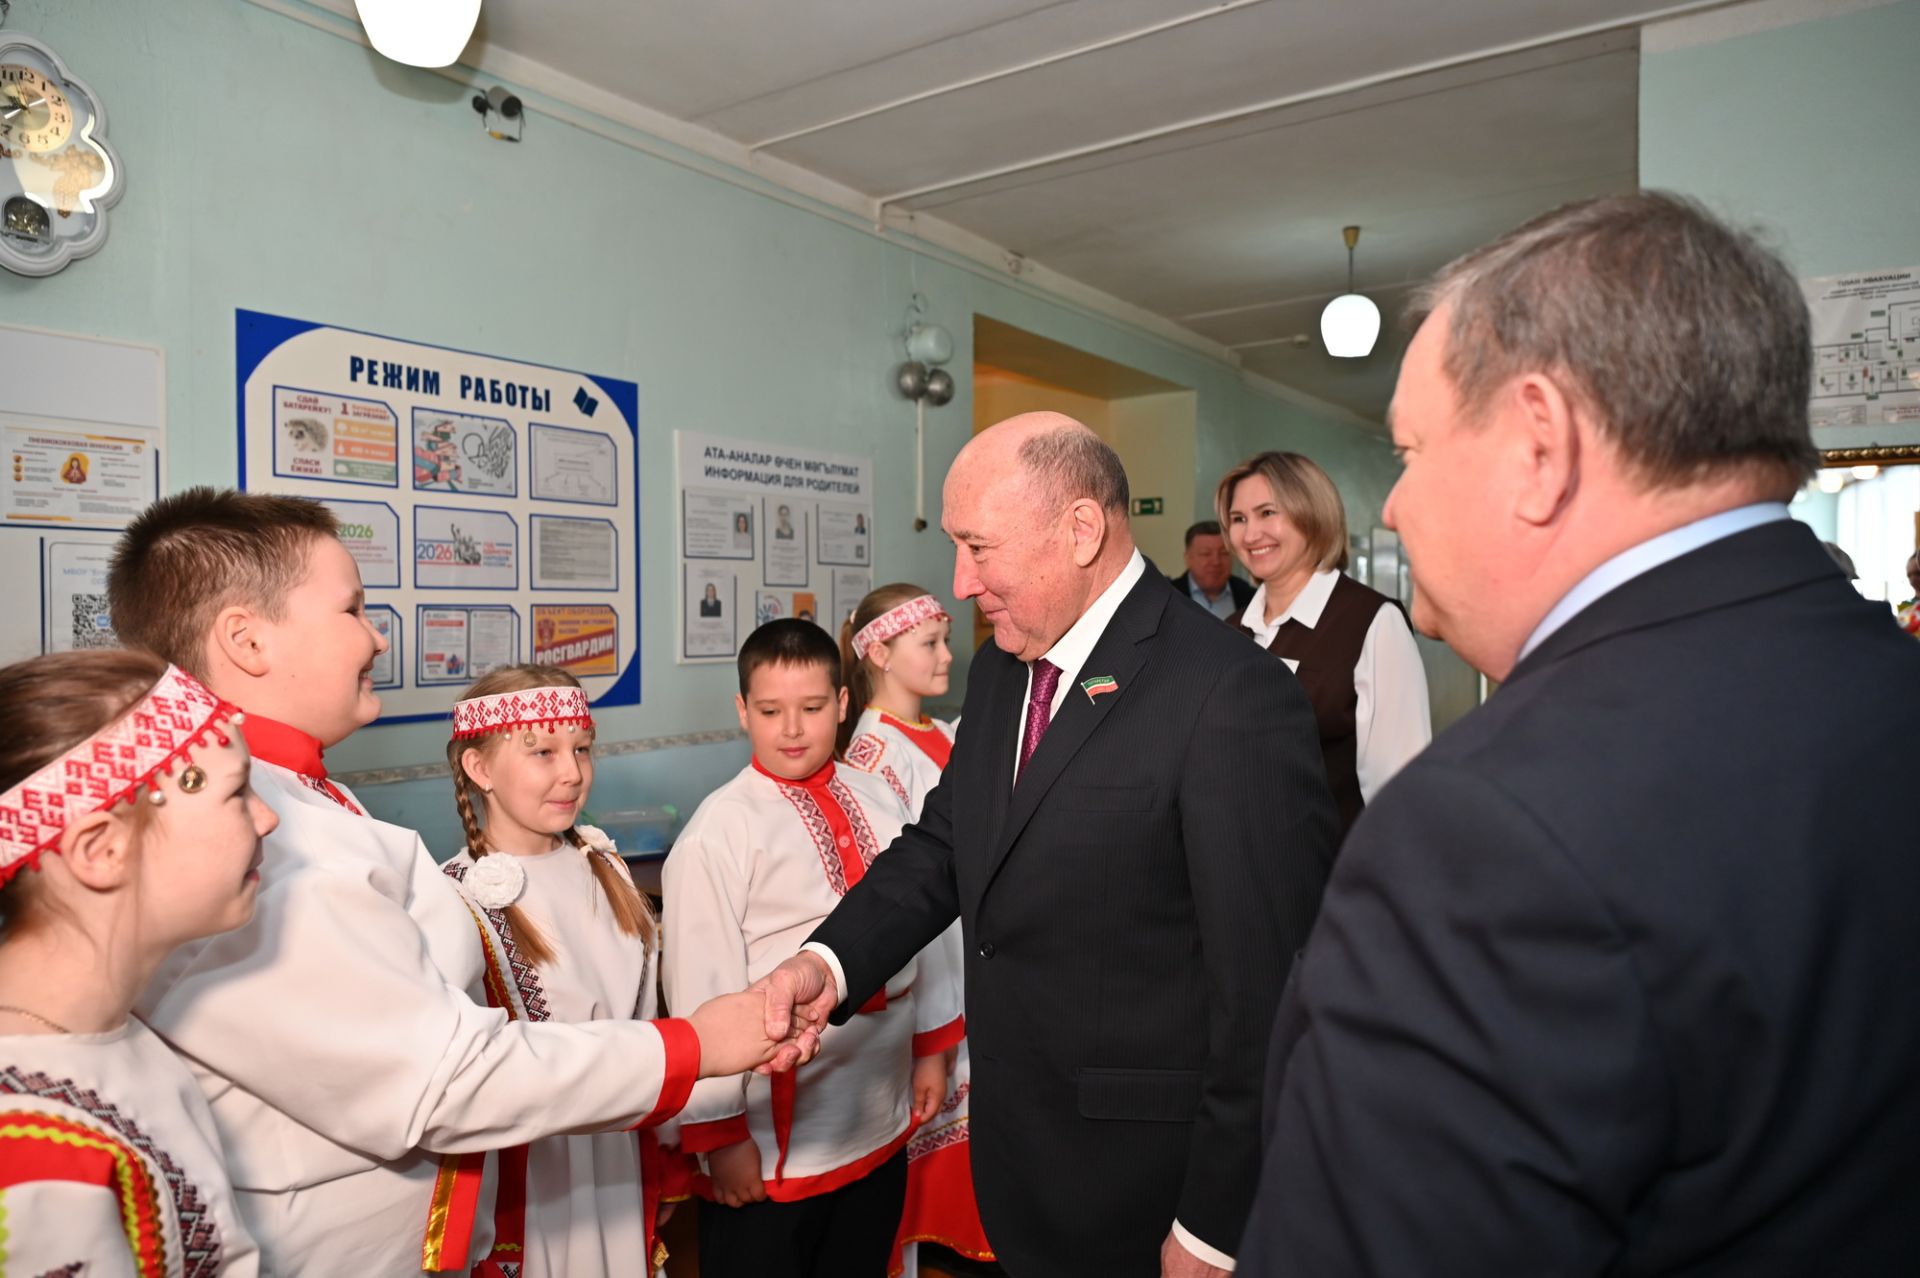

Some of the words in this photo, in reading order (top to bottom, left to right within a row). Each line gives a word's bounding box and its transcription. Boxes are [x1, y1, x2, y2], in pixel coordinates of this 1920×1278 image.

[51, 95, 62, 107] 2
[55, 112, 65, 123] 3
[50, 127, 60, 136] 4
[350, 355, 440, 396] РЕЖИМ
[460, 374, 550, 413] РАБОТЫ
[341, 402, 349, 415] 1
[704, 446, 772, 467] АТА-АНАЛАР
[704, 466, 781, 486] ИНФОРМАЦИЯ
[783, 475, 804, 488] ДЛЯ
[806, 478, 860, 494] РОДИТЕЛЕЙ
[339, 524, 373, 538] 2026
[417, 543, 452, 560] 2026
[536, 633, 614, 666] РОСГВАРДИИ
